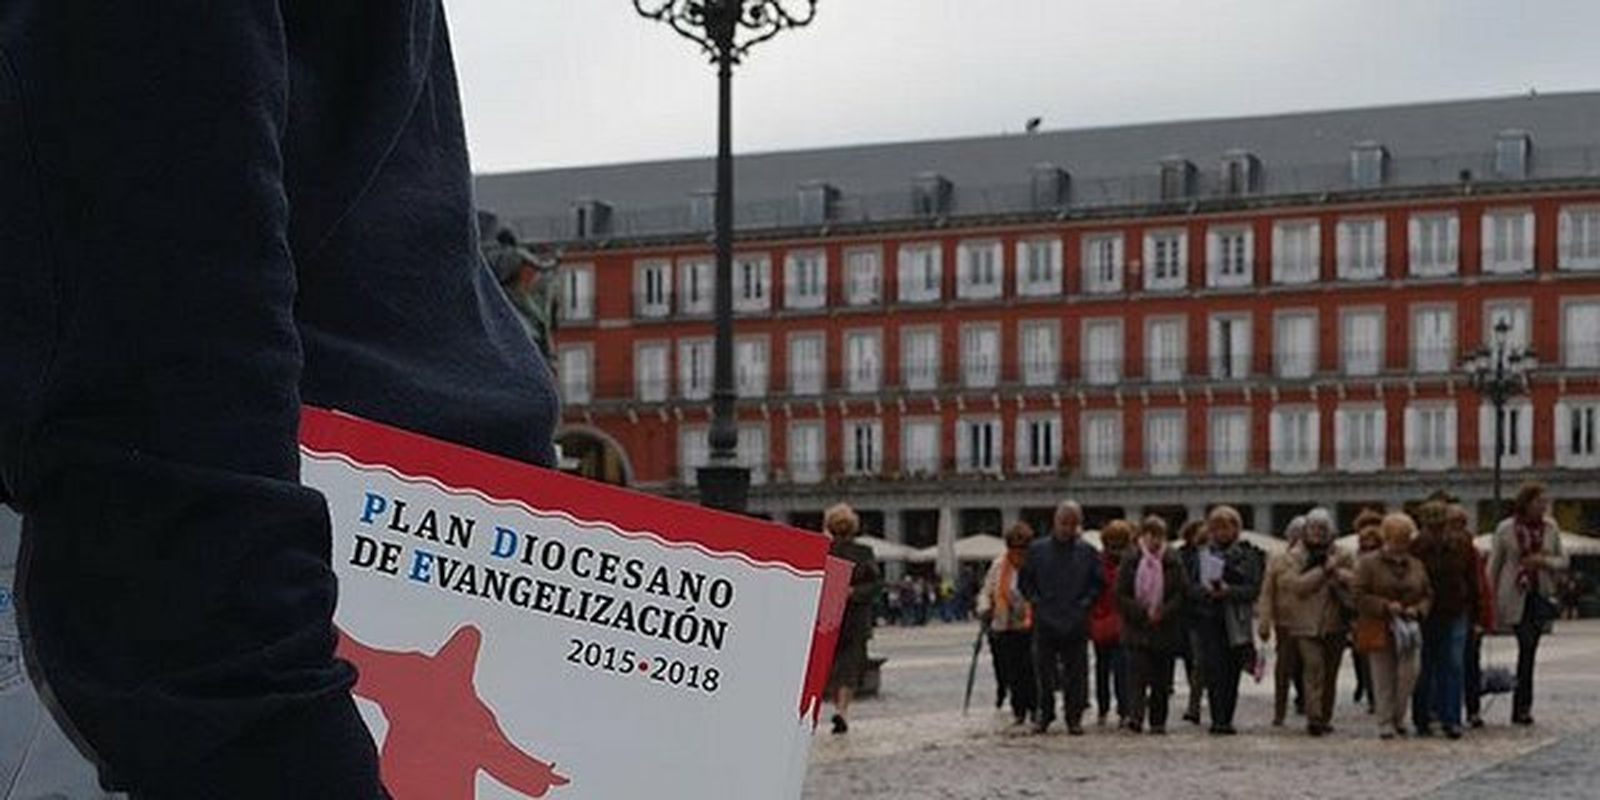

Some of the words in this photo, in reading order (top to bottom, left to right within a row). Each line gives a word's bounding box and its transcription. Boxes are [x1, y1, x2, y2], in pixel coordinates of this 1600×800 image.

[350, 535, 400, 574] DE
[408, 550, 728, 650] EVANGELIZACIÓN
[360, 493, 475, 549] PLAN
[491, 526, 733, 608] DIOCESANO
